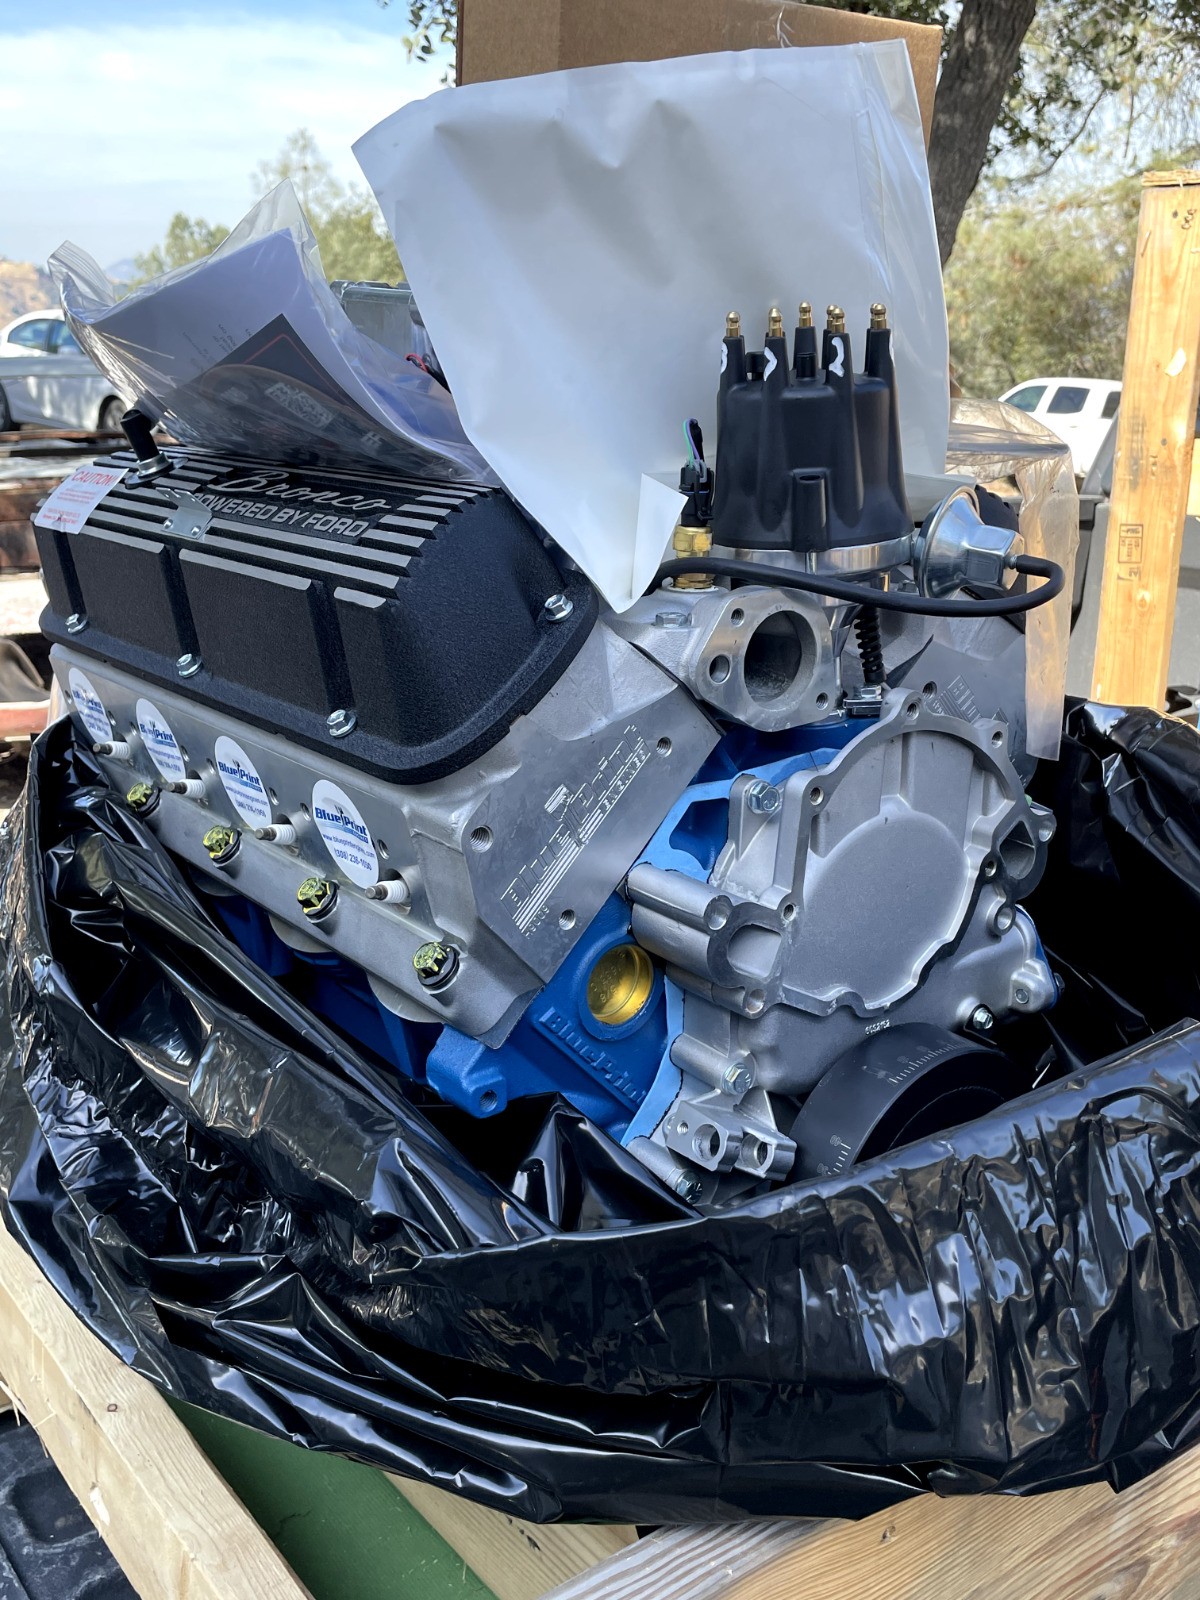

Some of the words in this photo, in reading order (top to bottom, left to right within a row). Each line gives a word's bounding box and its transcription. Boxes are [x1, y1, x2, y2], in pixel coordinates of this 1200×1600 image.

[71, 471, 119, 486] CAUTION!
[207, 470, 392, 511] Bronco
[271, 508, 308, 525] BY
[301, 513, 369, 538] FORD
[314, 806, 341, 824] Blue
[343, 815, 368, 836] Print
